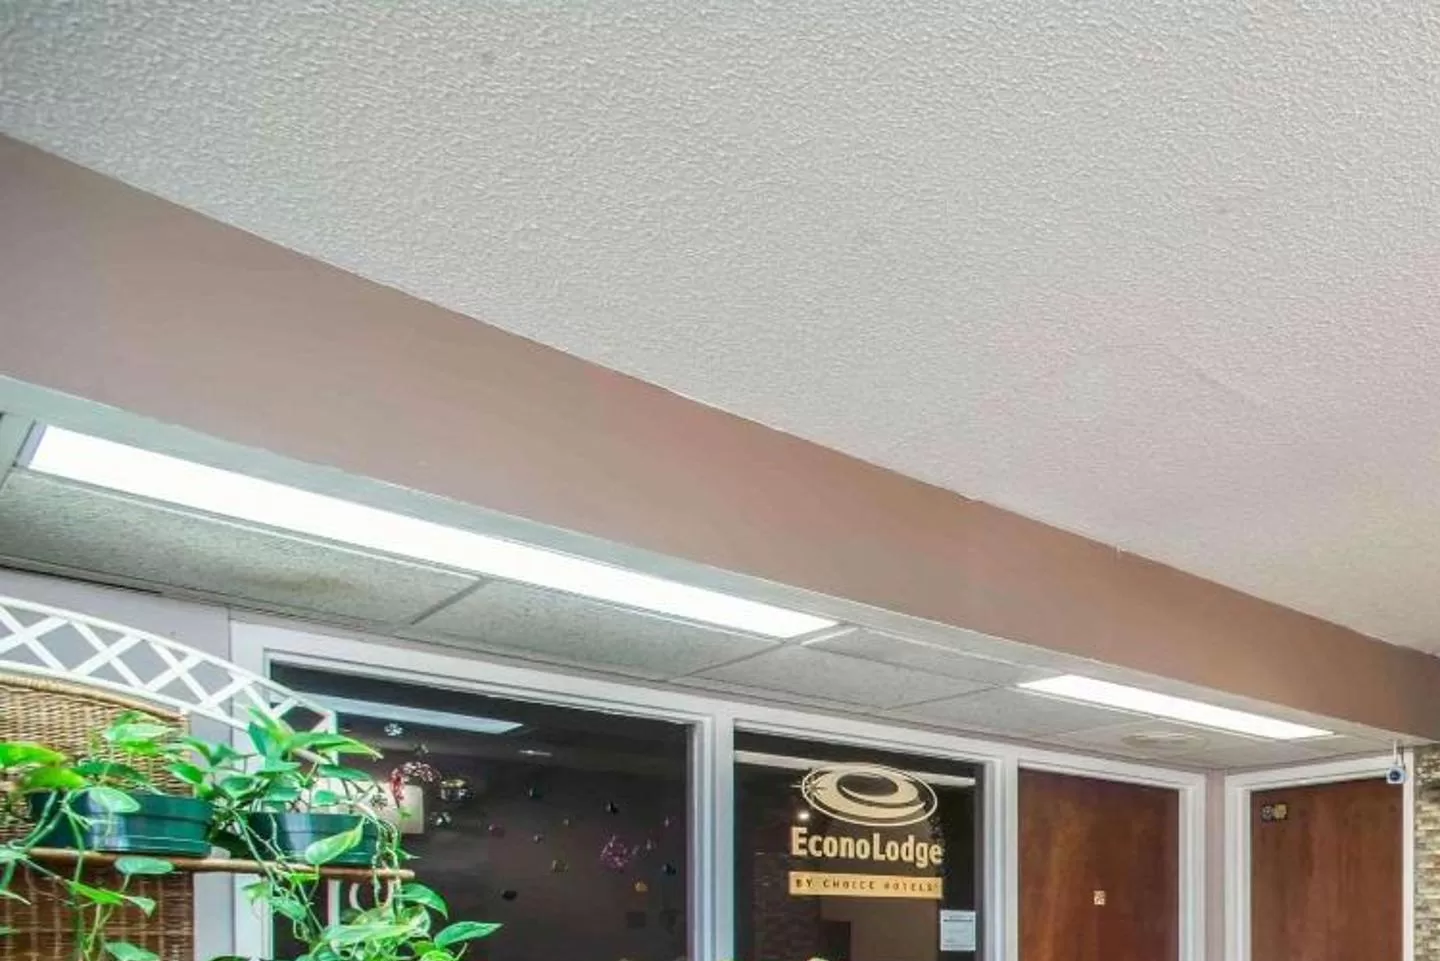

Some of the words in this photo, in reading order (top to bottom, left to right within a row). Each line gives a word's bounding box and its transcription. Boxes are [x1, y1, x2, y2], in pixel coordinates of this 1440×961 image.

[791, 826, 943, 869] EconoLodge
[796, 878, 813, 889] BY
[822, 878, 876, 891] CHOICE
[883, 881, 934, 893] HOTELS
